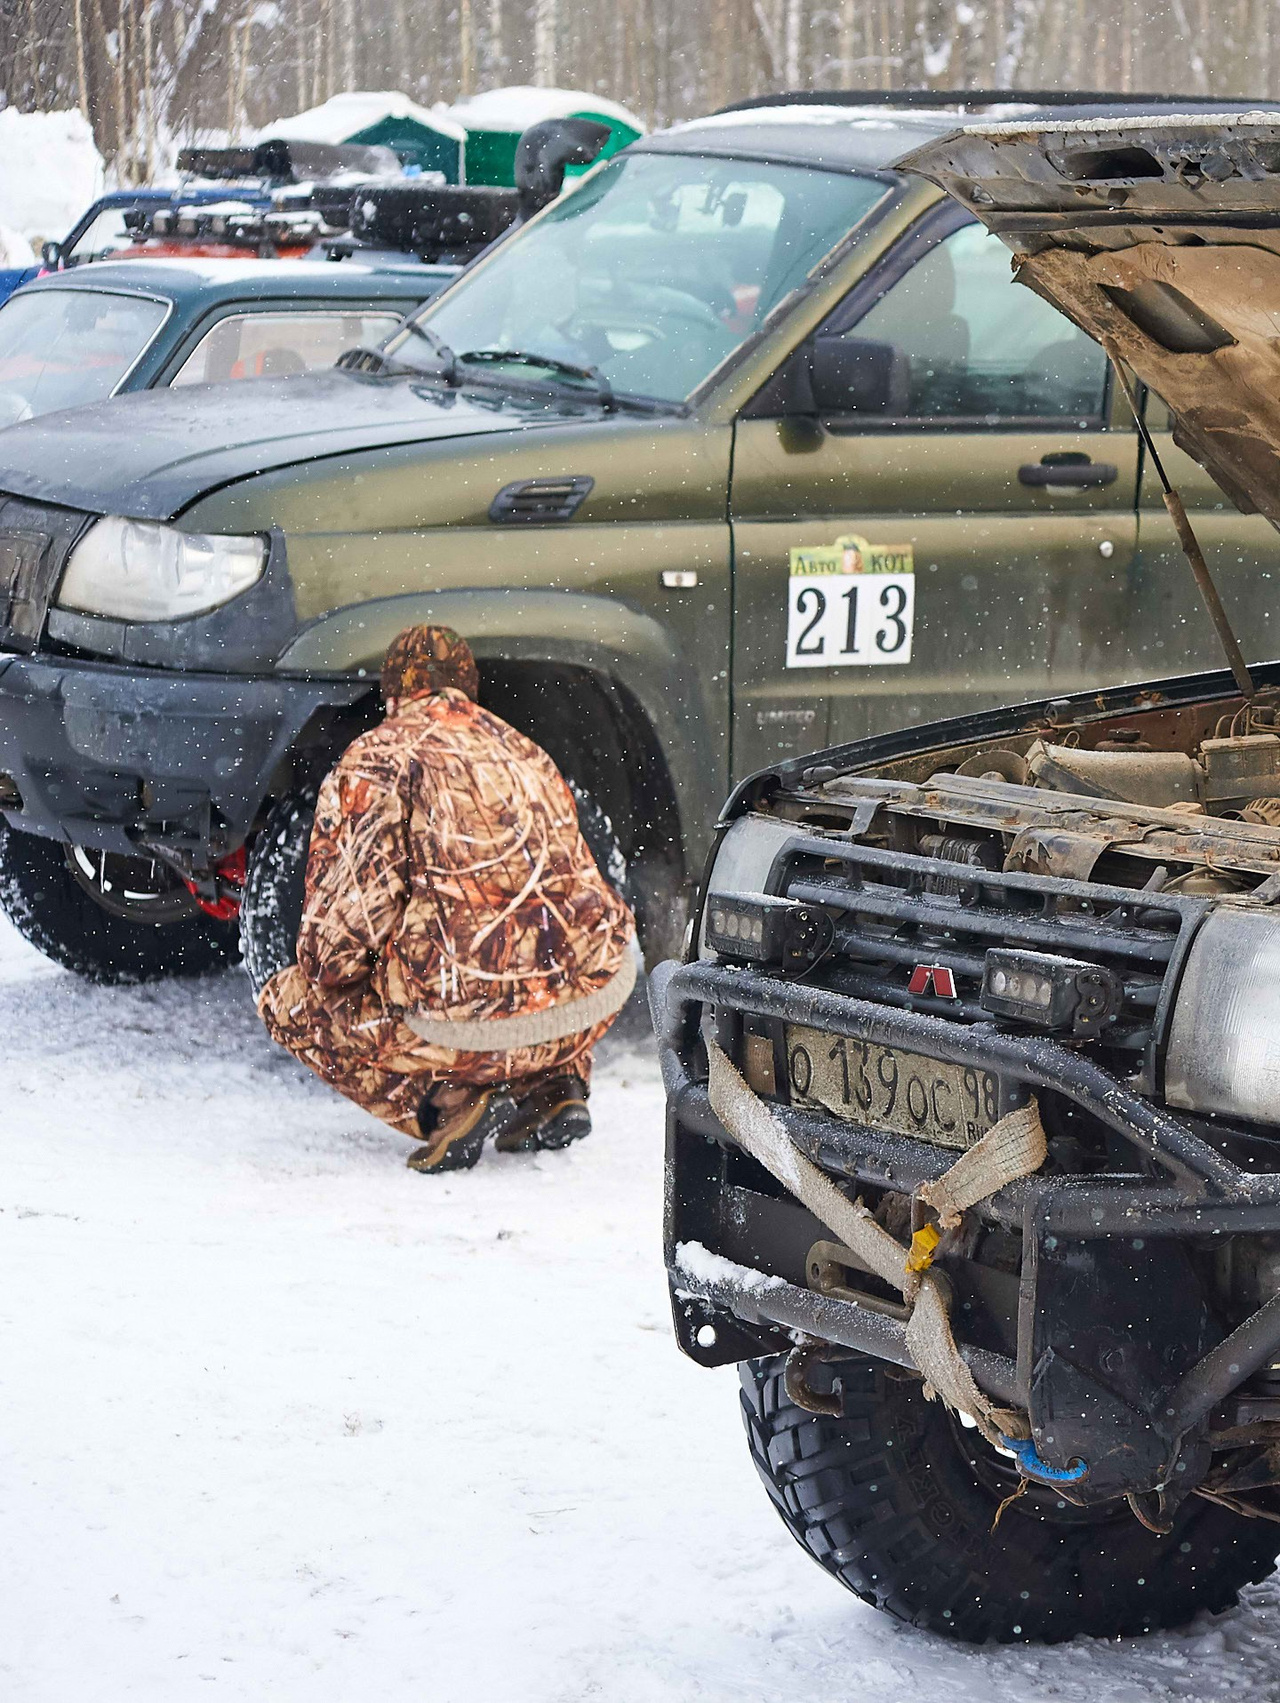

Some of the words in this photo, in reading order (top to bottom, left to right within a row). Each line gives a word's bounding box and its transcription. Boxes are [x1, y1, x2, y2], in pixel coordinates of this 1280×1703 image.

[871, 554, 908, 573] КОТ
[795, 584, 908, 656] 213
[964, 1065, 999, 1124] 98
